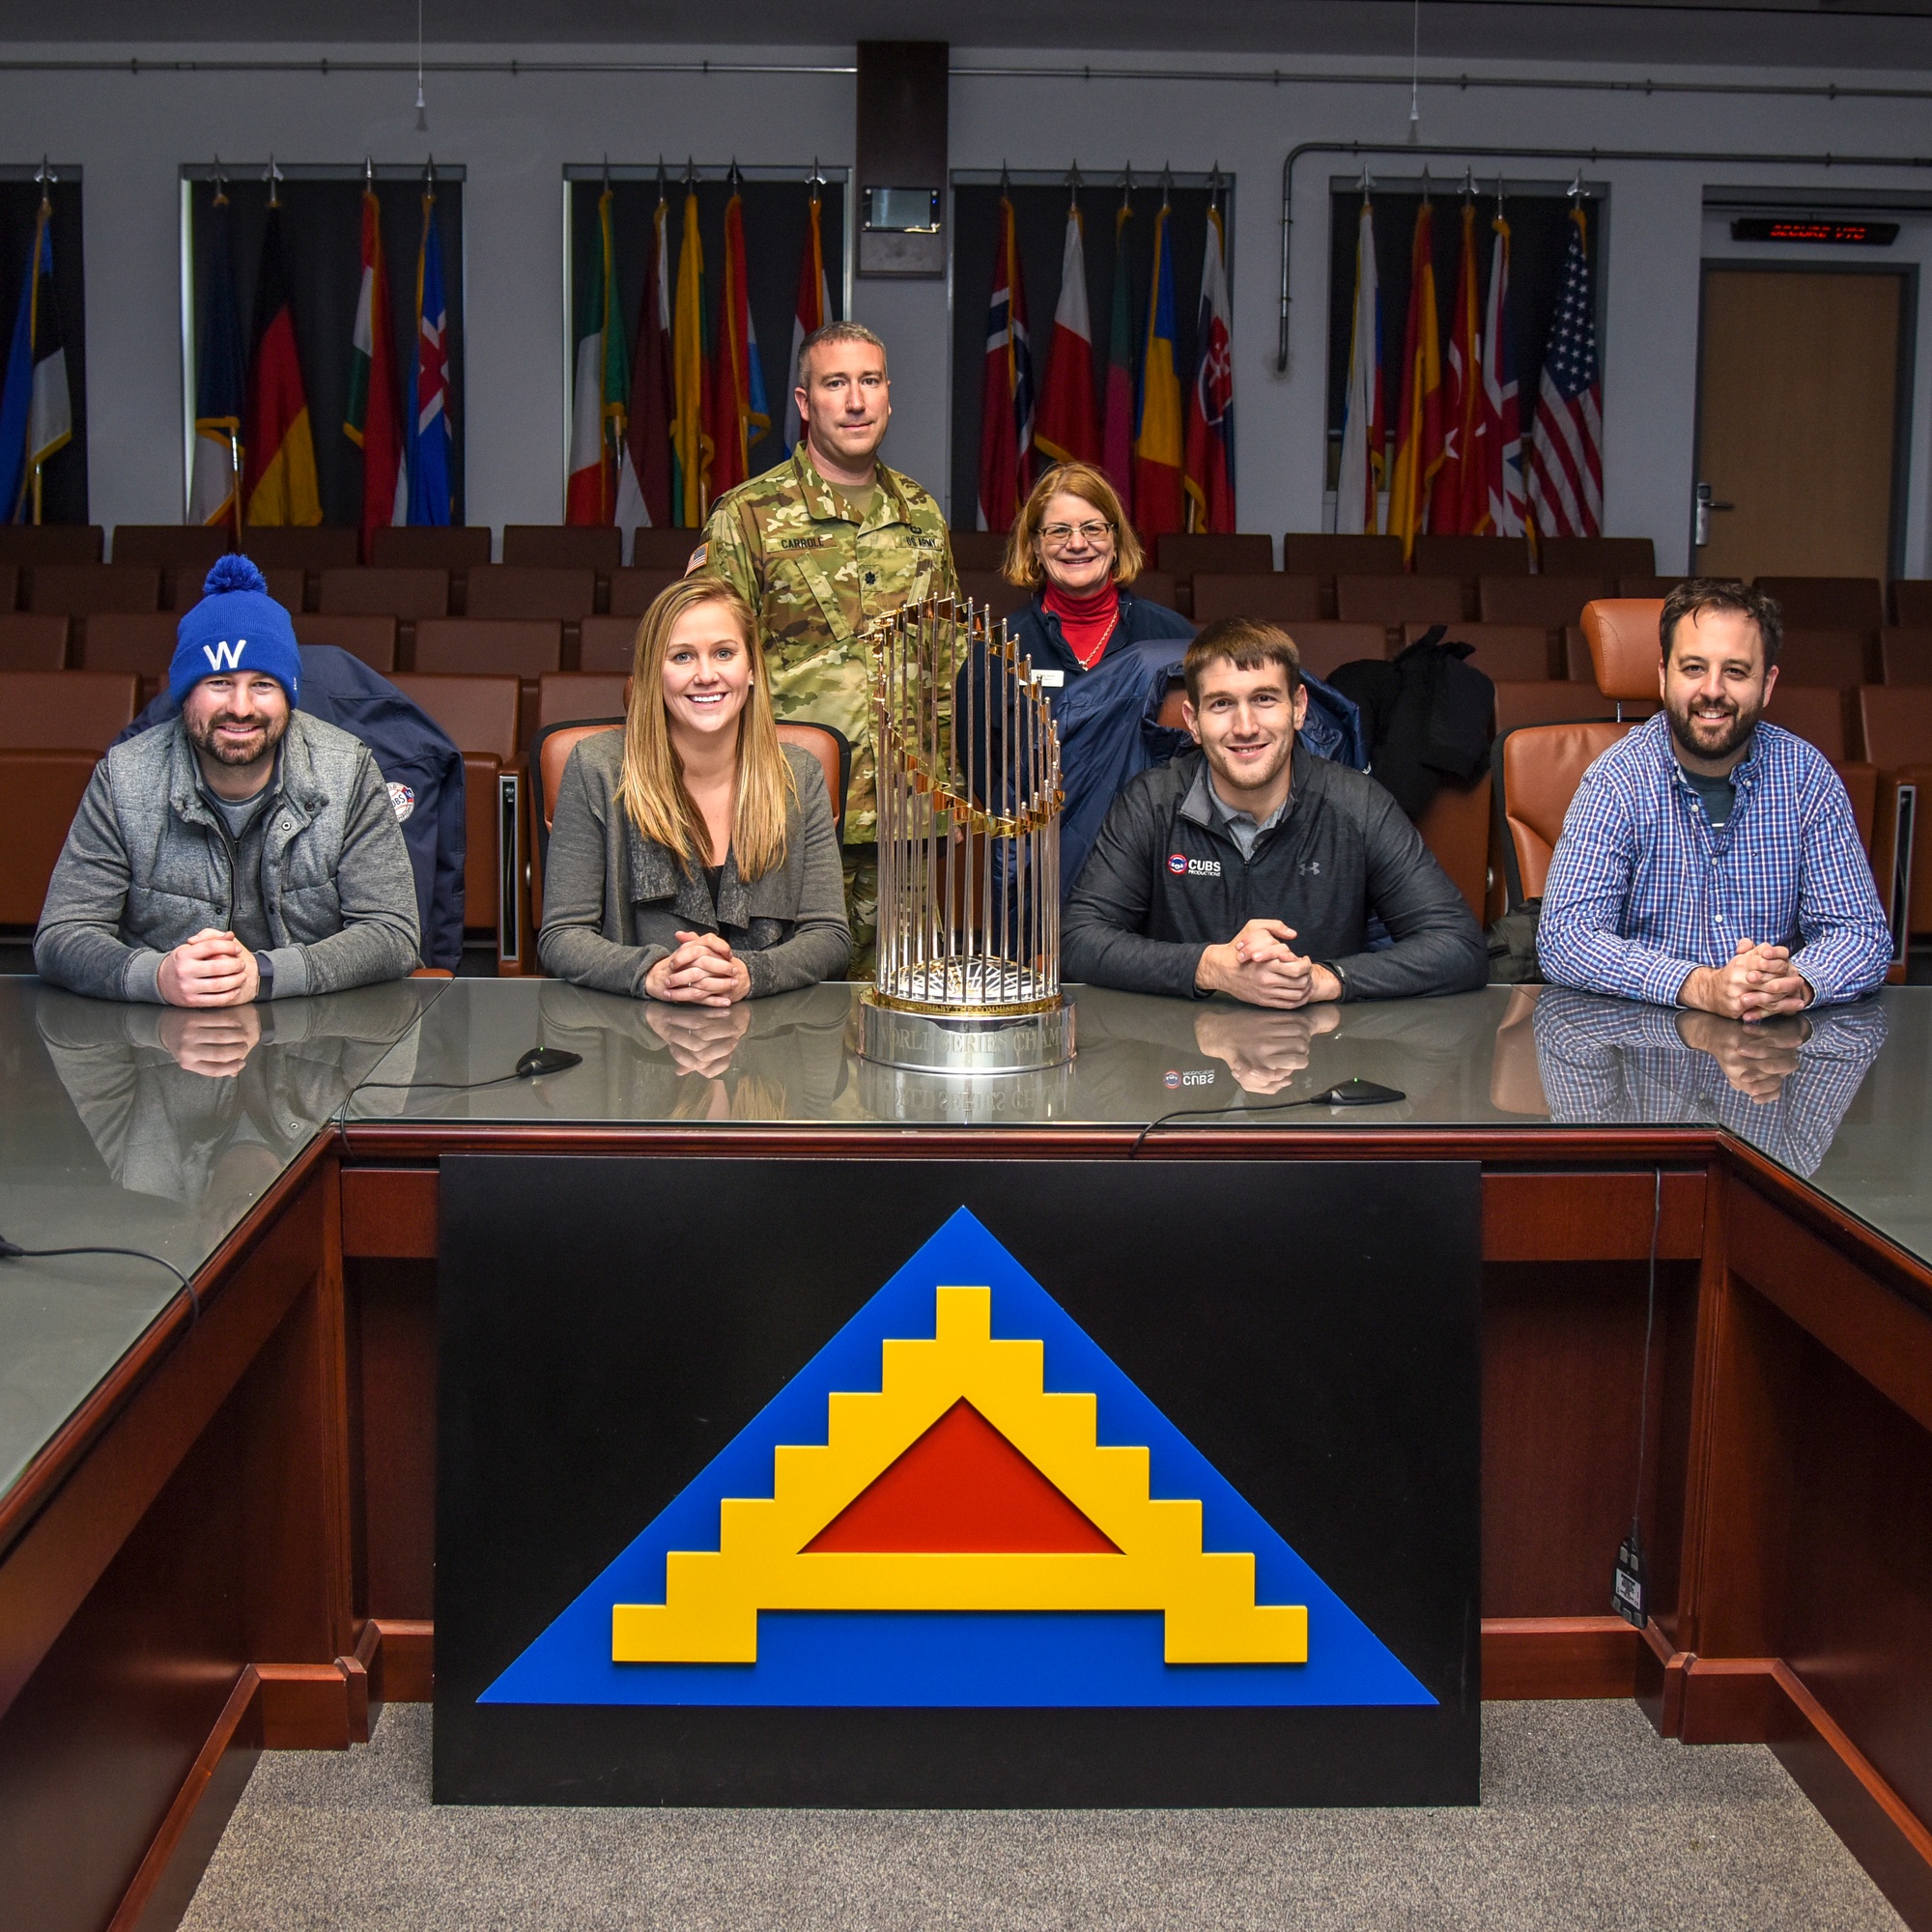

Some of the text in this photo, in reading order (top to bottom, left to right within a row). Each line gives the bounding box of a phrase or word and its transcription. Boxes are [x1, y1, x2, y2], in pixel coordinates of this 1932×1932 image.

[781, 537, 824, 549] CARROLL
[906, 536, 937, 548] US ARMY
[203, 639, 247, 671] W
[1188, 859, 1221, 872] CUBS
[939, 1032, 1006, 1053] SERIES
